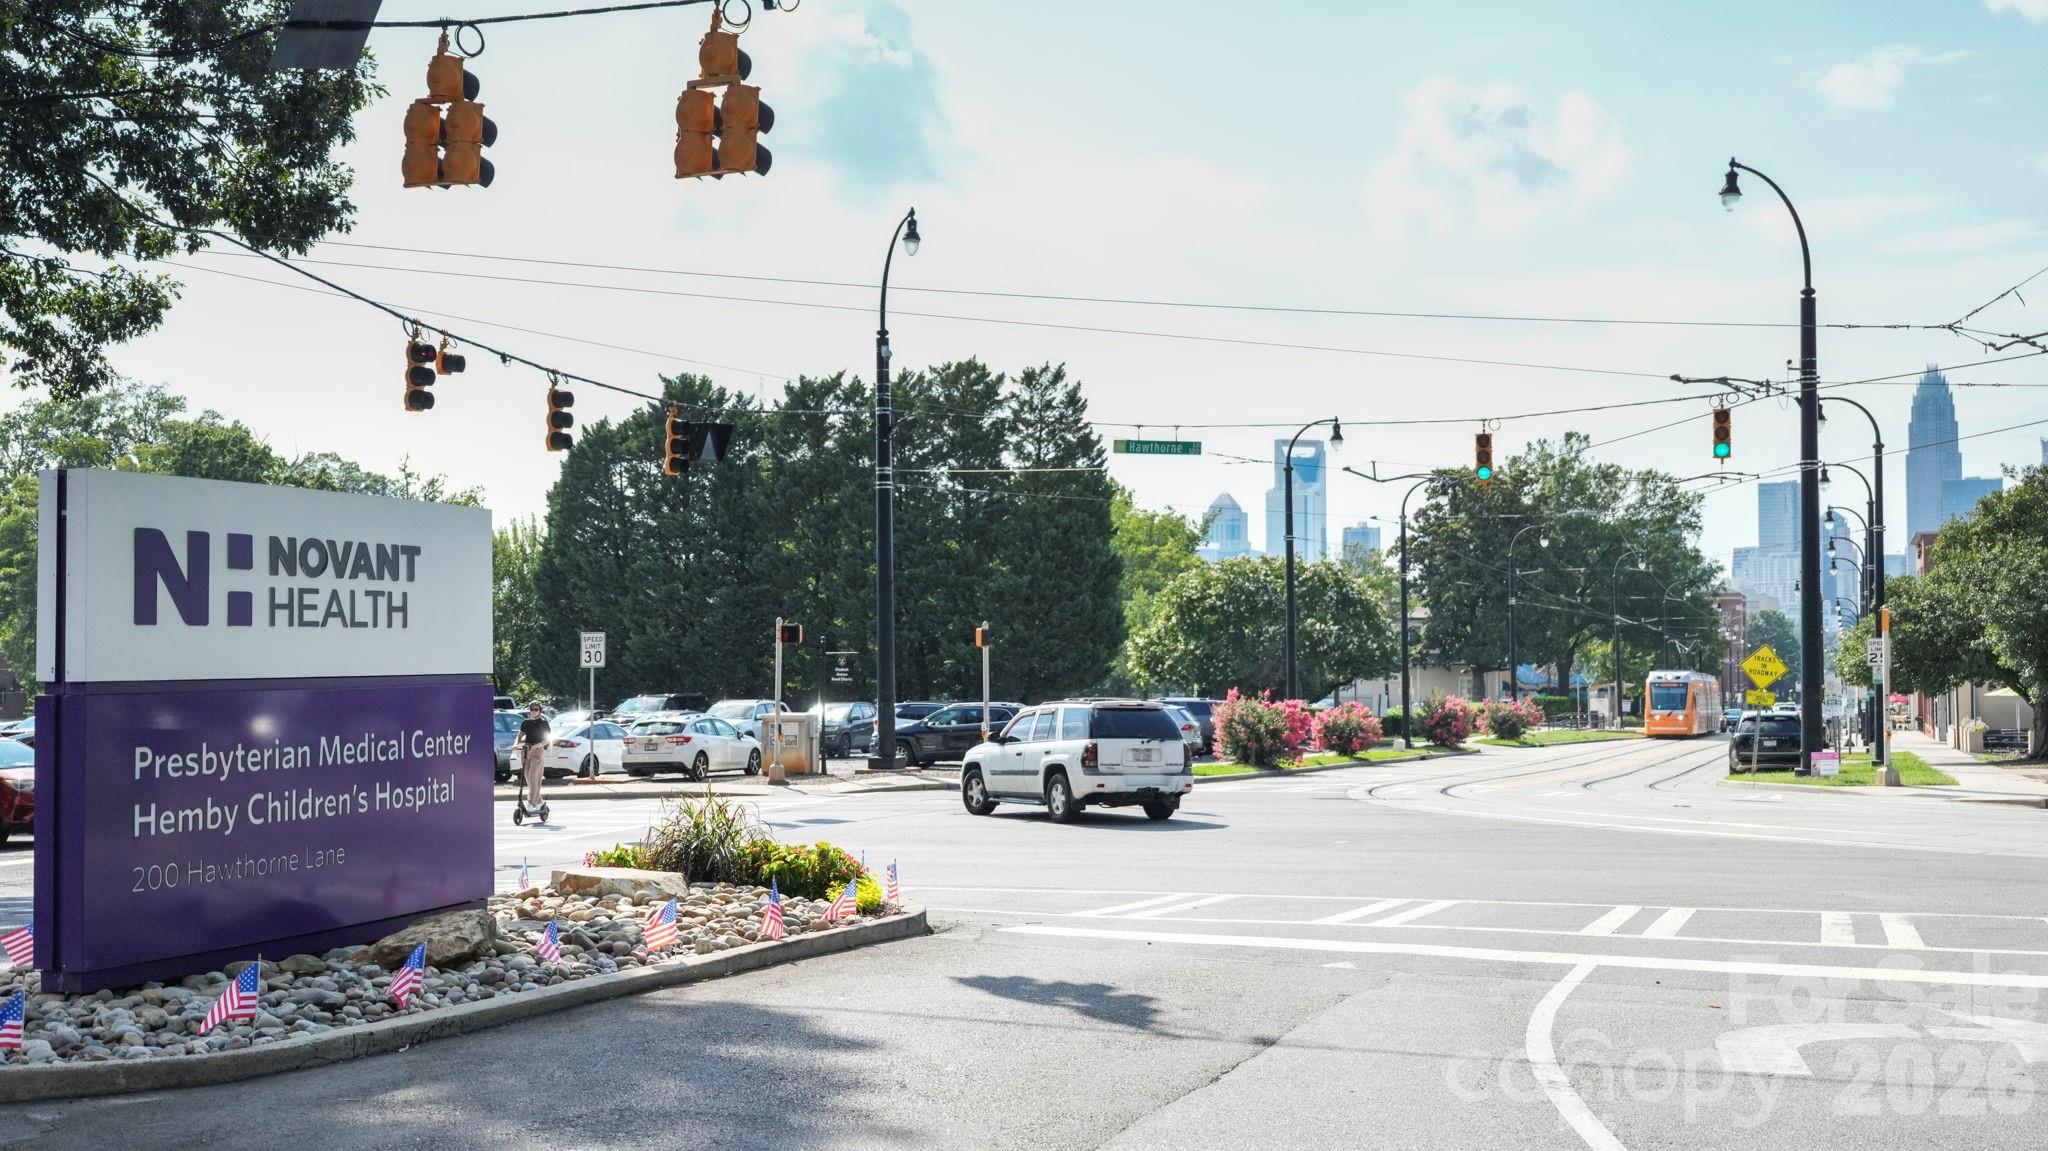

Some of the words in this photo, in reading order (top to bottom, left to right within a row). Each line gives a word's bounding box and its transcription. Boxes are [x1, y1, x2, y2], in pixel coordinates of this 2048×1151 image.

[1129, 442, 1184, 454] Hawthorne
[269, 536, 421, 582] NOVANT
[269, 587, 407, 628] HEALTH
[584, 650, 602, 663] 30
[1749, 668, 1778, 677] ROADWAY
[1754, 655, 1777, 664] TRACKS
[134, 738, 311, 782] Presbyterian
[319, 730, 405, 767] Medical
[411, 729, 471, 759] Center
[134, 796, 239, 837] Hemby
[247, 784, 369, 825] Children's
[375, 773, 455, 813] Hospital
[132, 862, 179, 893] 200
[188, 852, 299, 885] Hawthorne
[306, 845, 346, 869] Lane
